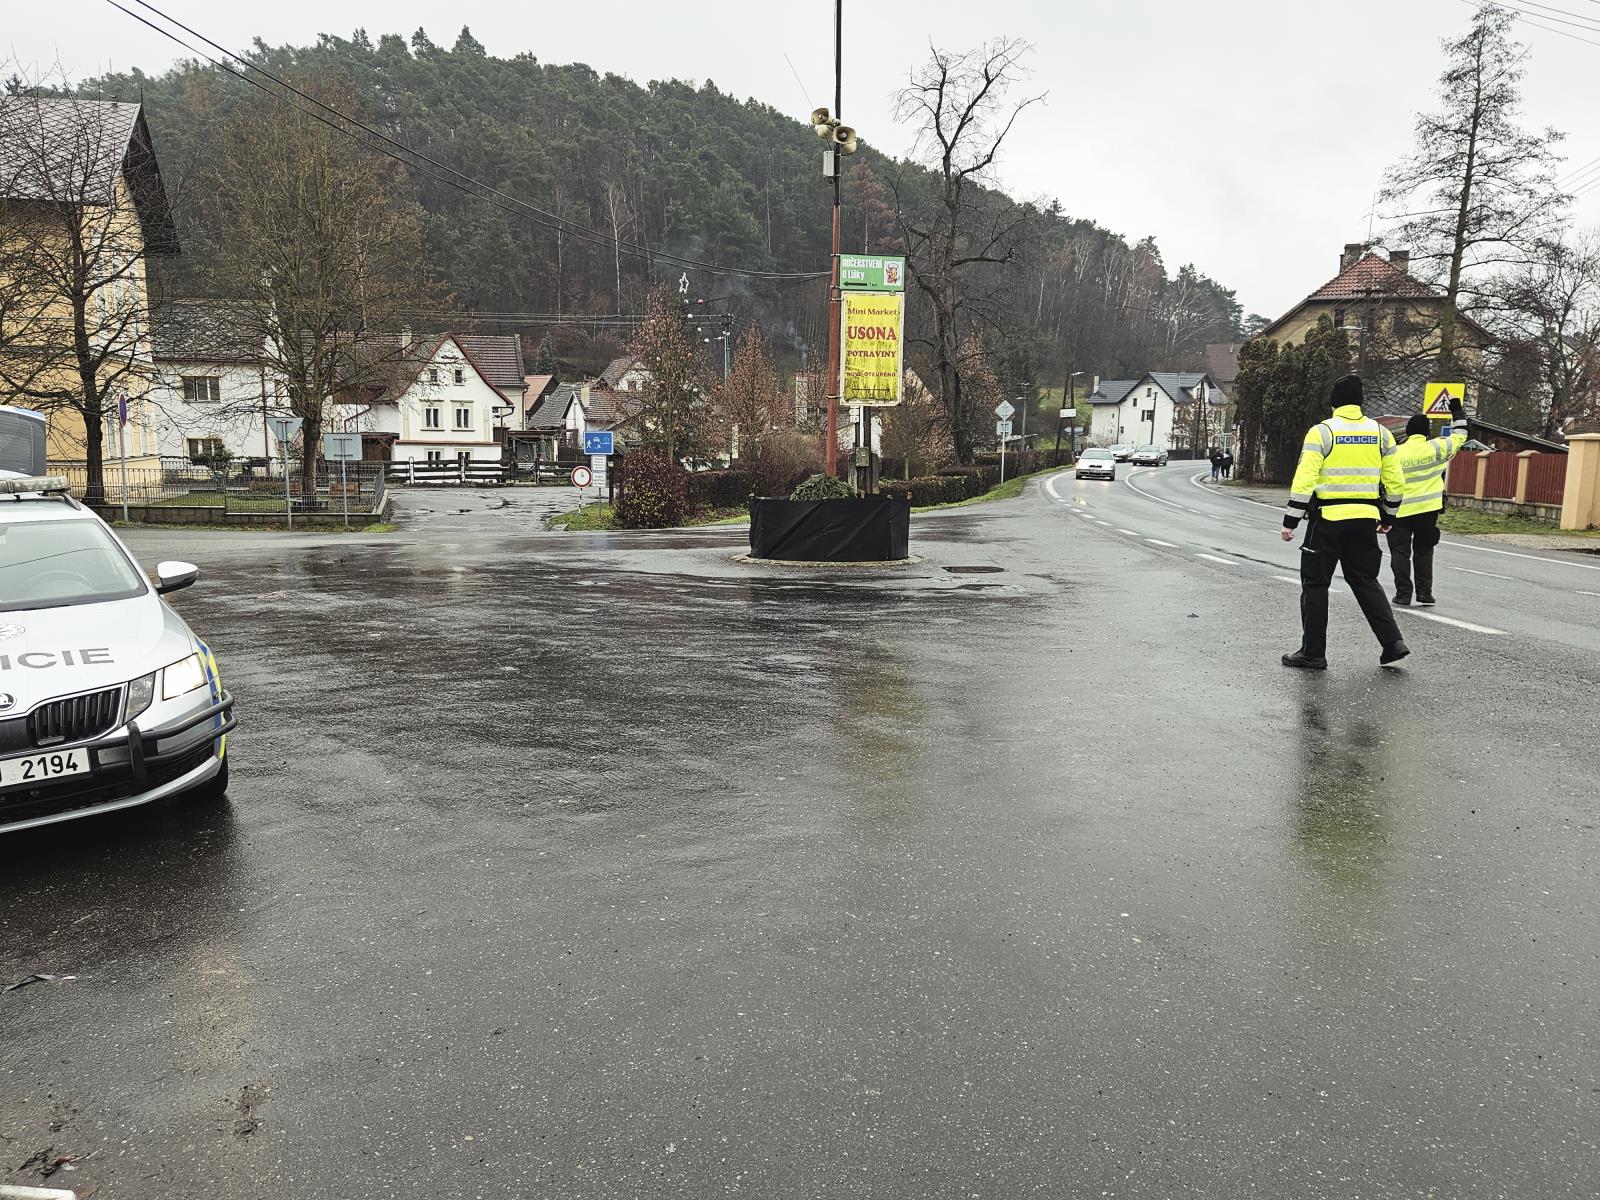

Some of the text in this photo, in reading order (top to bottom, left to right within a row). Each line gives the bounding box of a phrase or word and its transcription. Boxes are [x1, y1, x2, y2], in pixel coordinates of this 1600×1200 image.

[842, 269, 848, 279] U
[847, 307, 897, 316] Mini Market
[847, 325, 897, 341] USONA
[847, 350, 897, 358] POTRAVINY
[1336, 436, 1378, 444] POLICIE
[20, 752, 78, 780] 2194
